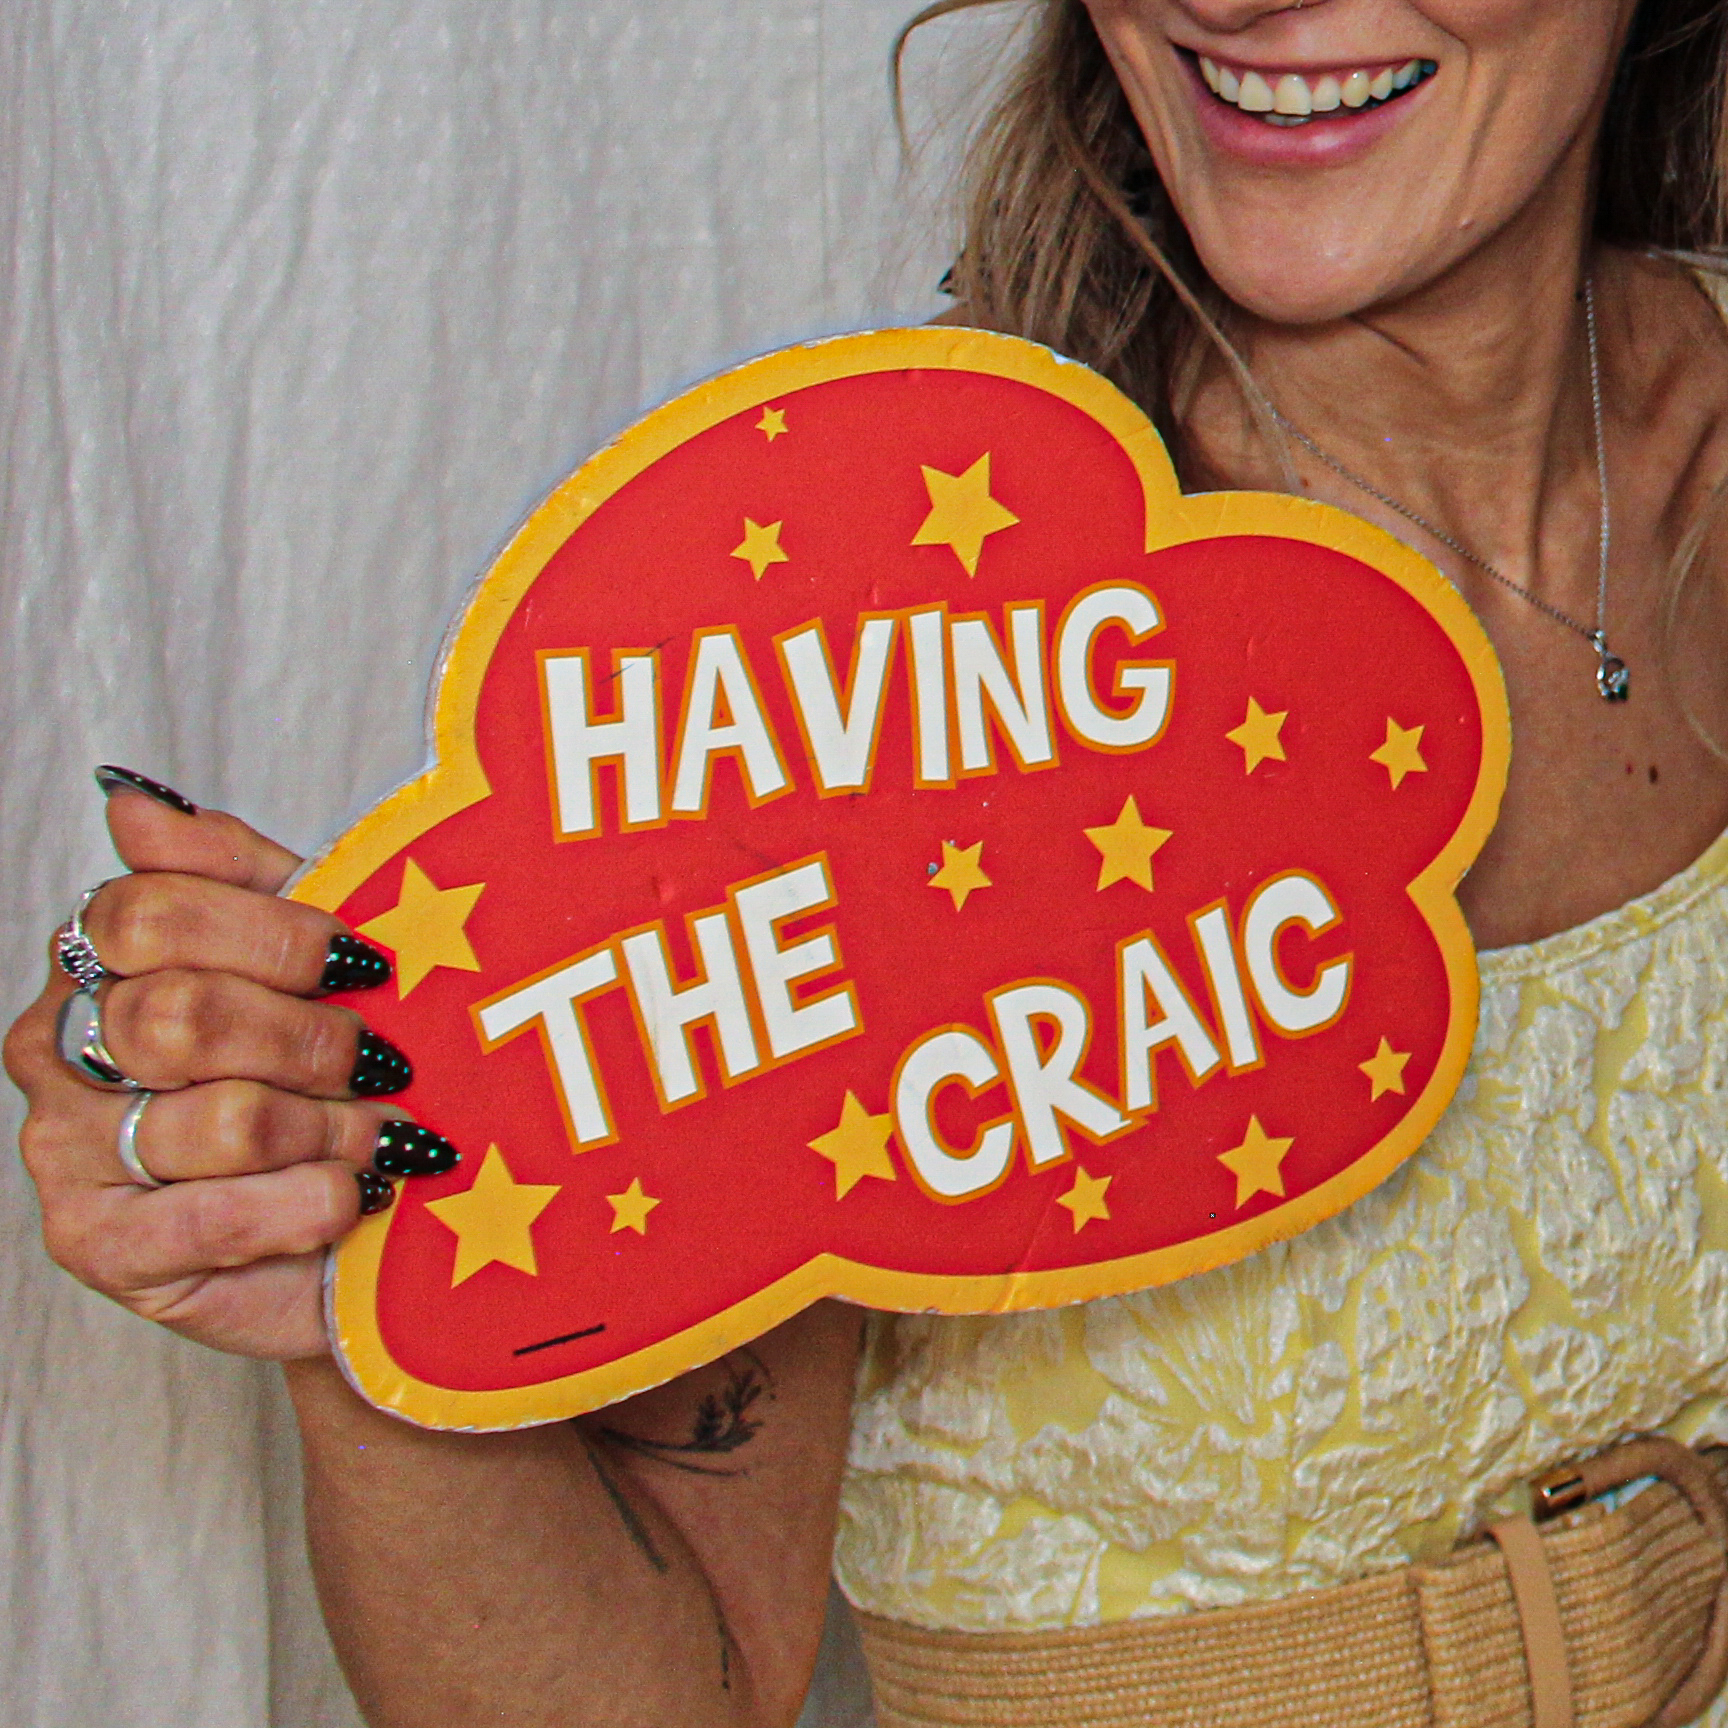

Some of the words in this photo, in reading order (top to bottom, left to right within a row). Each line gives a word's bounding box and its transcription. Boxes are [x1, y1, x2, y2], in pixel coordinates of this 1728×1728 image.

[539, 581, 1174, 841] HAVING
[474, 854, 860, 1151] THE
[892, 870, 1354, 1202] CRAIC
